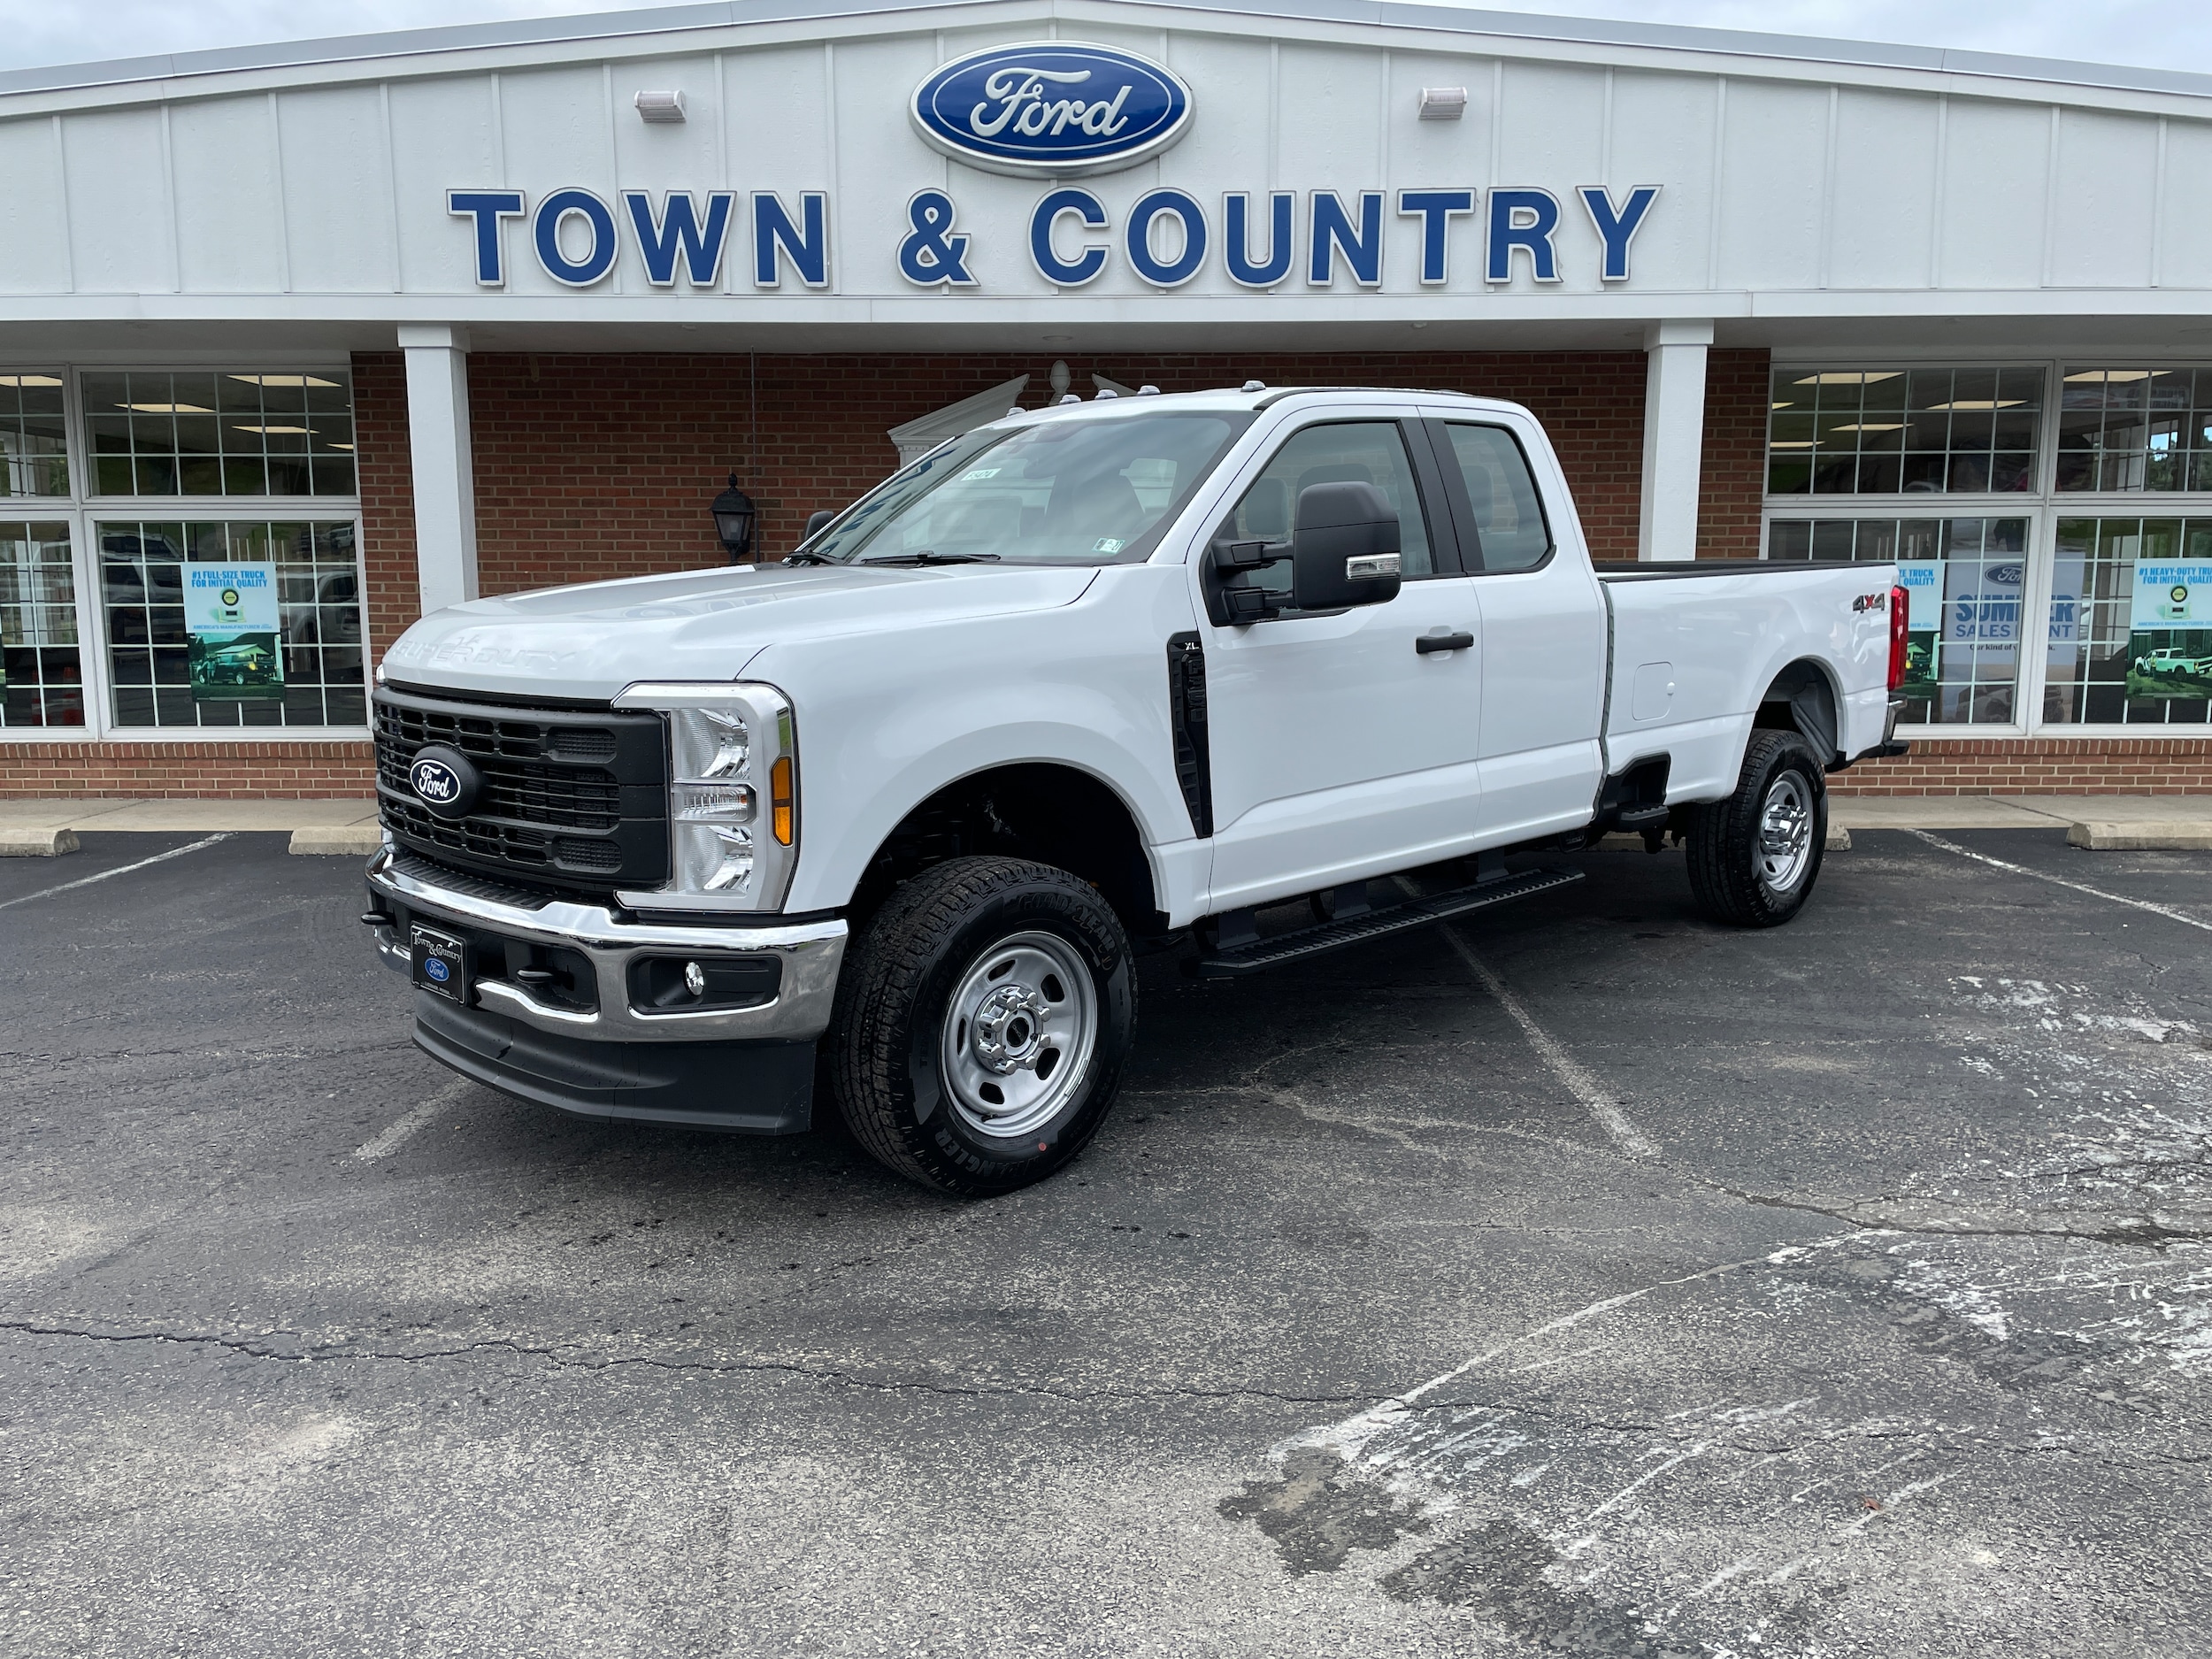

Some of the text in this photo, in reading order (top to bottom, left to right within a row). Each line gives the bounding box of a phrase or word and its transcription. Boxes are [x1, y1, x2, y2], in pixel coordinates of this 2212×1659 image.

[969, 67, 1133, 138] Ford
[446, 184, 1664, 288] TOWN & COUNTRY
[192, 570, 265, 580] #1 FULL-SIZE TRUCK
[1909, 569, 1934, 578] TRUCK
[1997, 566, 2022, 581] For
[2139, 567, 2148, 576] #1
[2150, 566, 2197, 576] HEAVY-DUTY
[191, 579, 267, 588] FOR INITIAL QUALITY
[1903, 577, 1935, 587] QUALITY
[2143, 575, 2158, 584] FOR
[2160, 575, 2185, 584] INITIAL
[1955, 594, 2075, 622] SUMR
[1955, 624, 2011, 638] SALES
[1184, 641, 1200, 651] XL
[394, 639, 576, 671] SUPER DUTY
[418, 764, 450, 798] Ford
